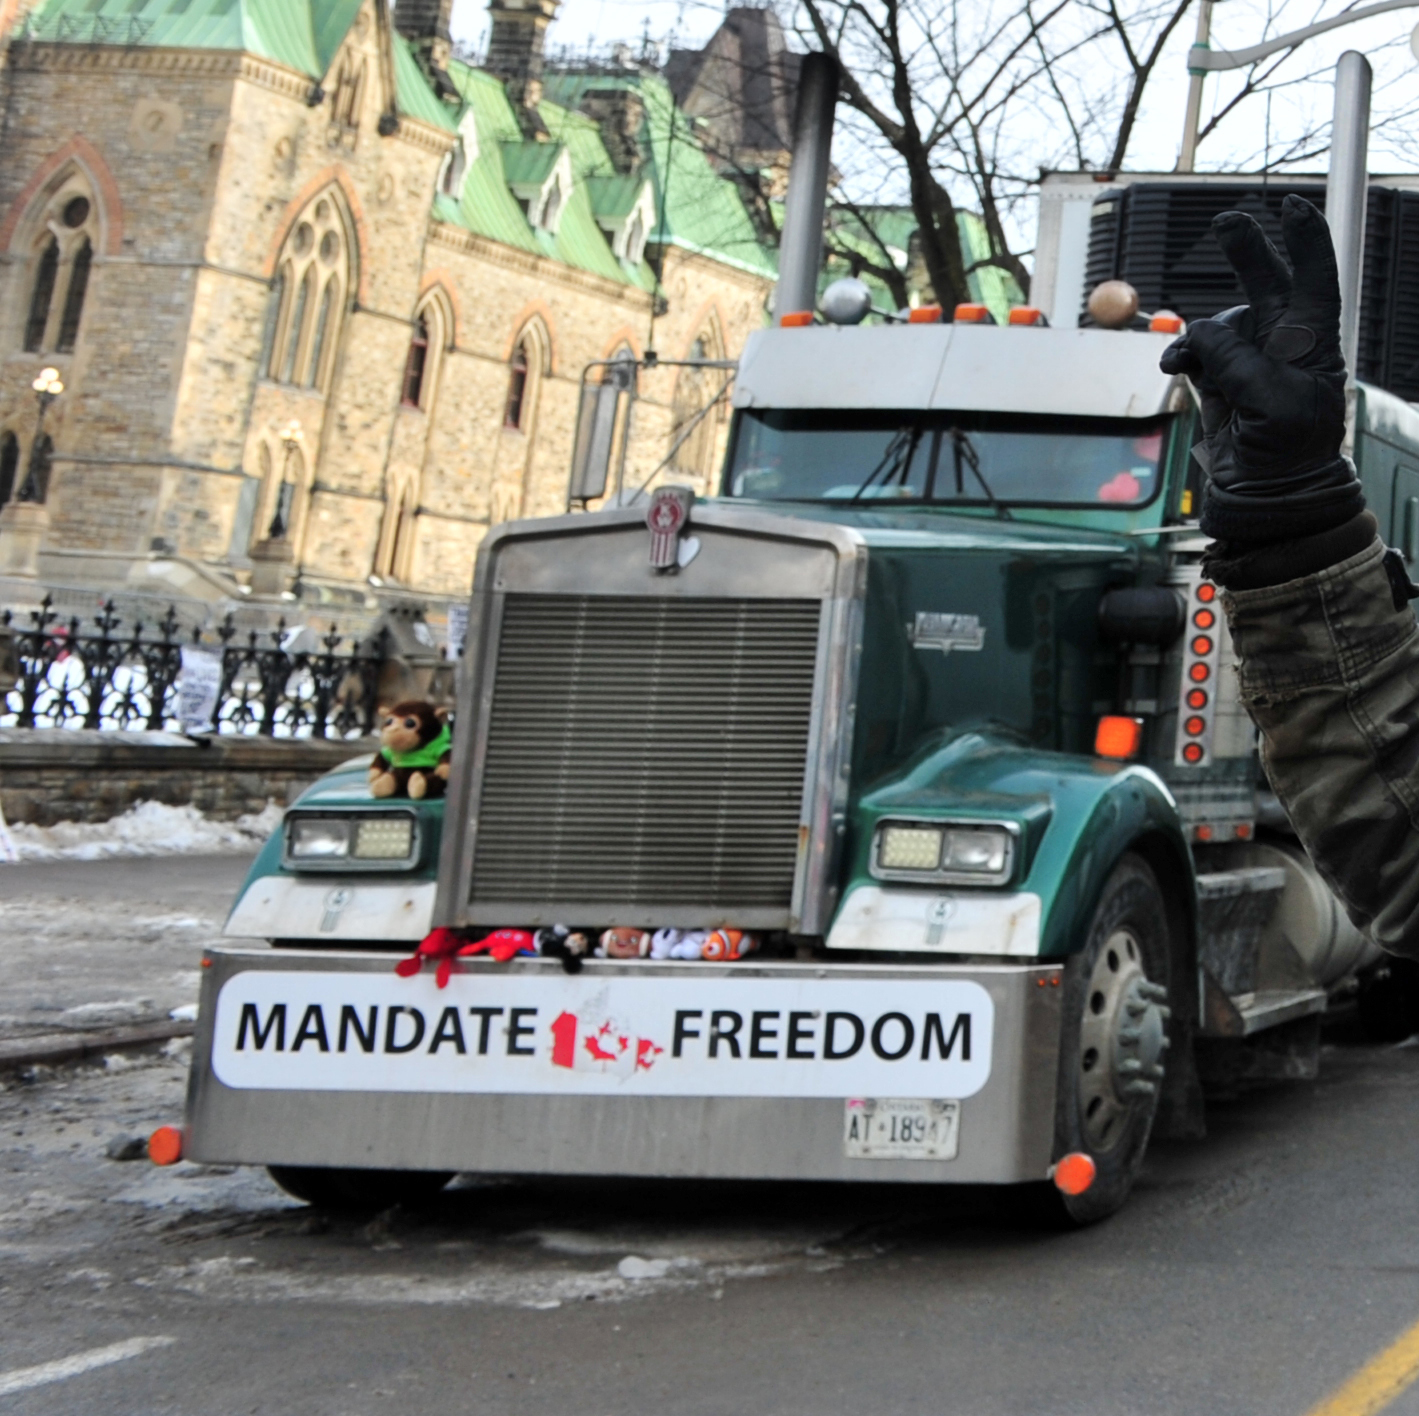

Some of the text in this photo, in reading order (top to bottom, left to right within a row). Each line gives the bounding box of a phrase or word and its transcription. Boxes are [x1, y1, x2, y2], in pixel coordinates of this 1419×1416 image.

[236, 1001, 974, 1064] MANDATE FREEDOM
[849, 1114, 873, 1143] AT
